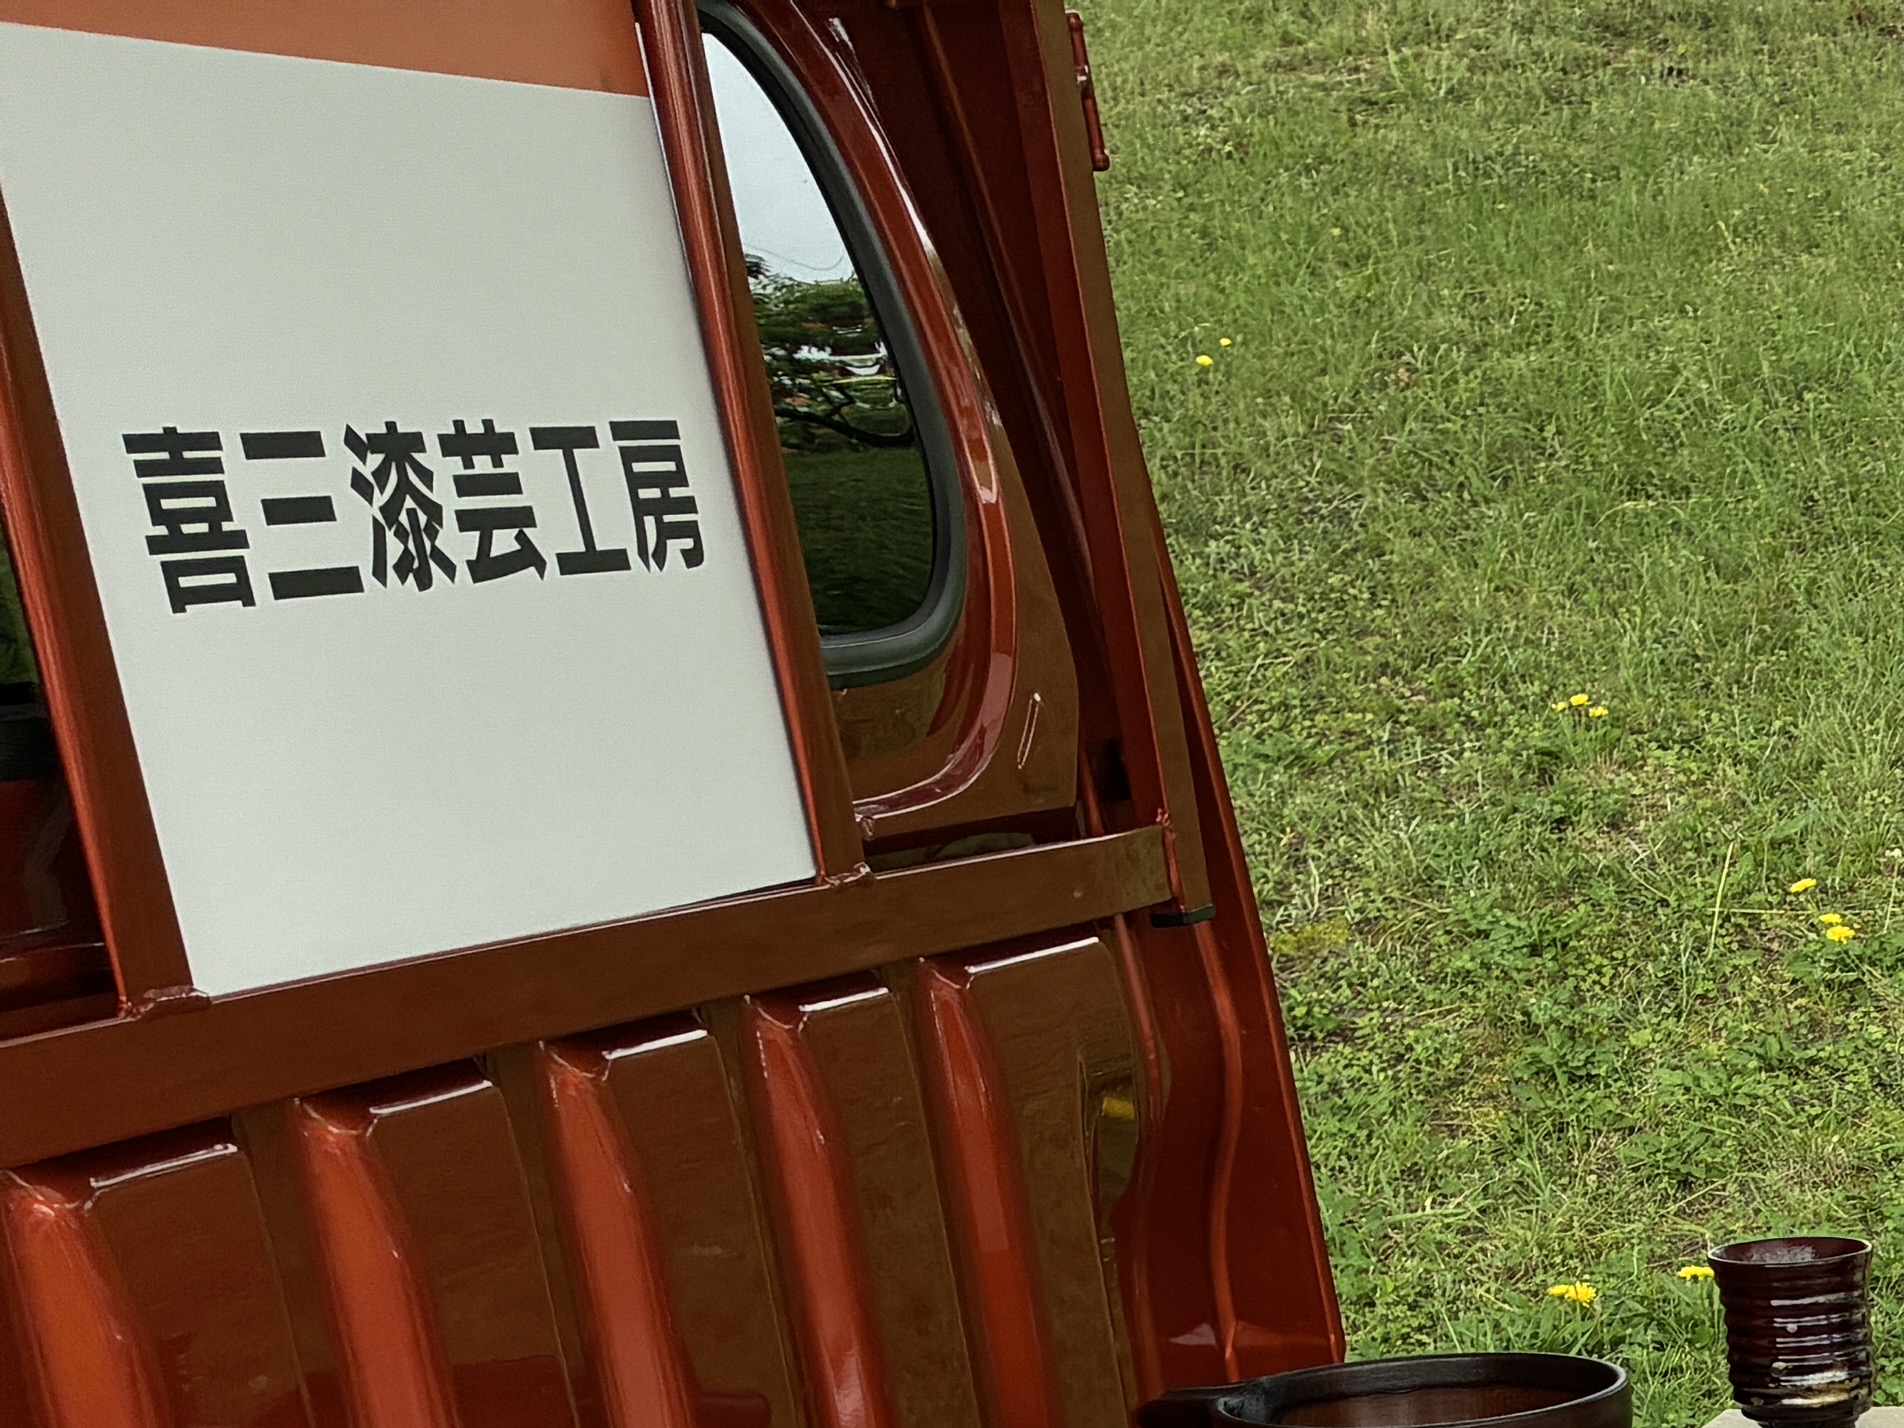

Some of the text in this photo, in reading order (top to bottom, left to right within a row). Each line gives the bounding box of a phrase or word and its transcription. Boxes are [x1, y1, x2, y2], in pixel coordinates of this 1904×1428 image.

[121, 418, 706, 614] 喜三漆芸工房
